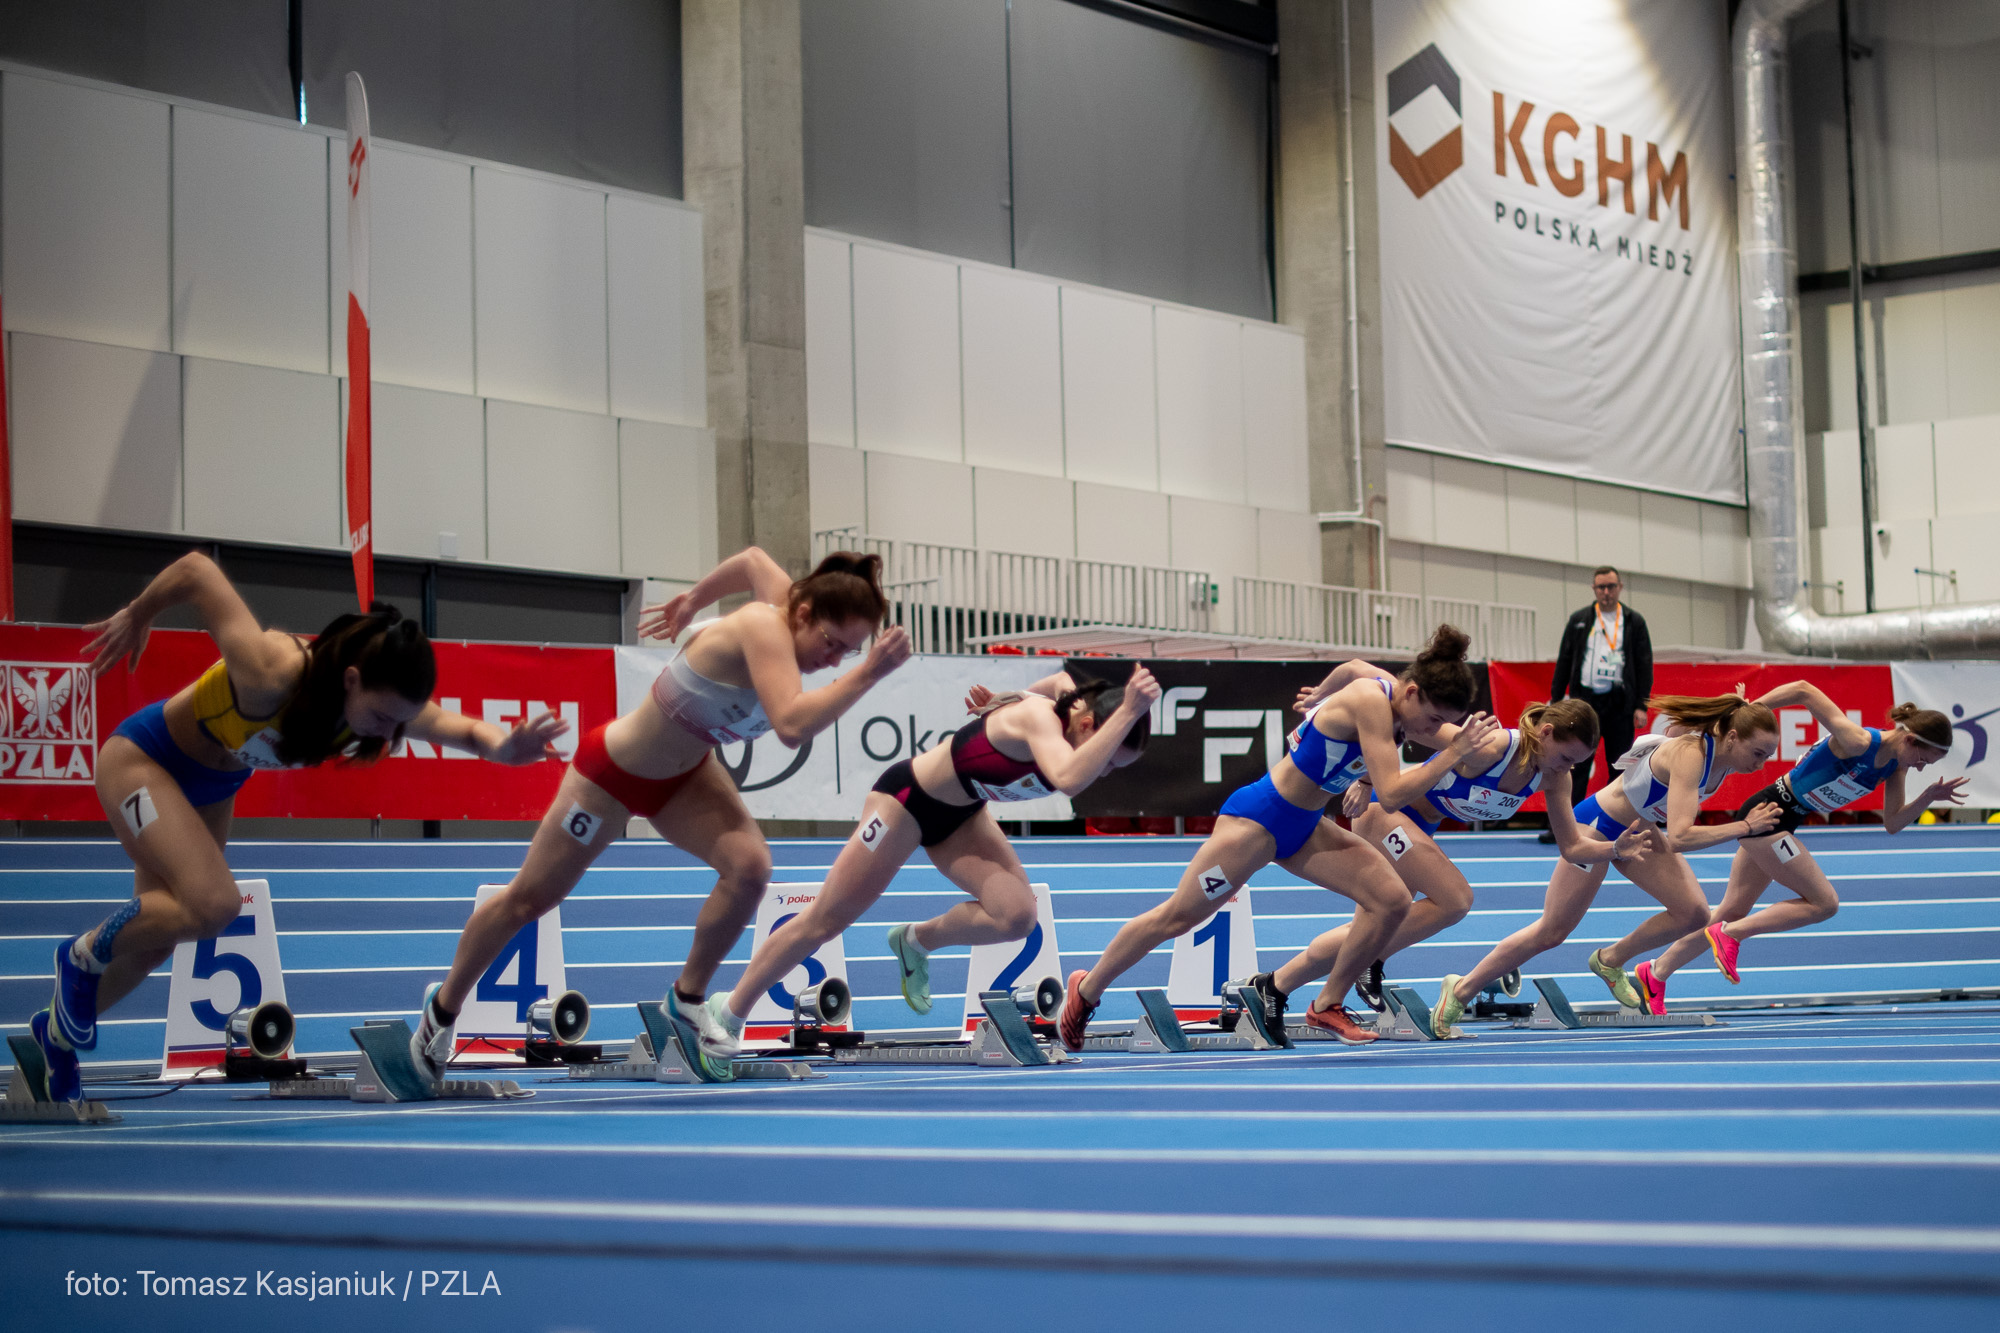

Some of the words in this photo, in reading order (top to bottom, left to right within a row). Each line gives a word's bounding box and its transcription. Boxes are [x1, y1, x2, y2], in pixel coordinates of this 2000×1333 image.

[1492, 90, 1690, 232] KGHM
[1495, 200, 1601, 252] POLSKA
[341, 696, 580, 762] LEN
[0, 744, 92, 779] PZLA
[125, 792, 143, 829] 7
[1497, 796, 1520, 808] 200
[569, 812, 592, 837] 6
[861, 817, 883, 842] 5
[1388, 833, 1406, 854] 3
[1779, 839, 1795, 857] 1
[1204, 876, 1227, 894] 4
[476, 916, 549, 1024] 4
[1193, 910, 1232, 997] 1
[190, 914, 263, 1032] 5
